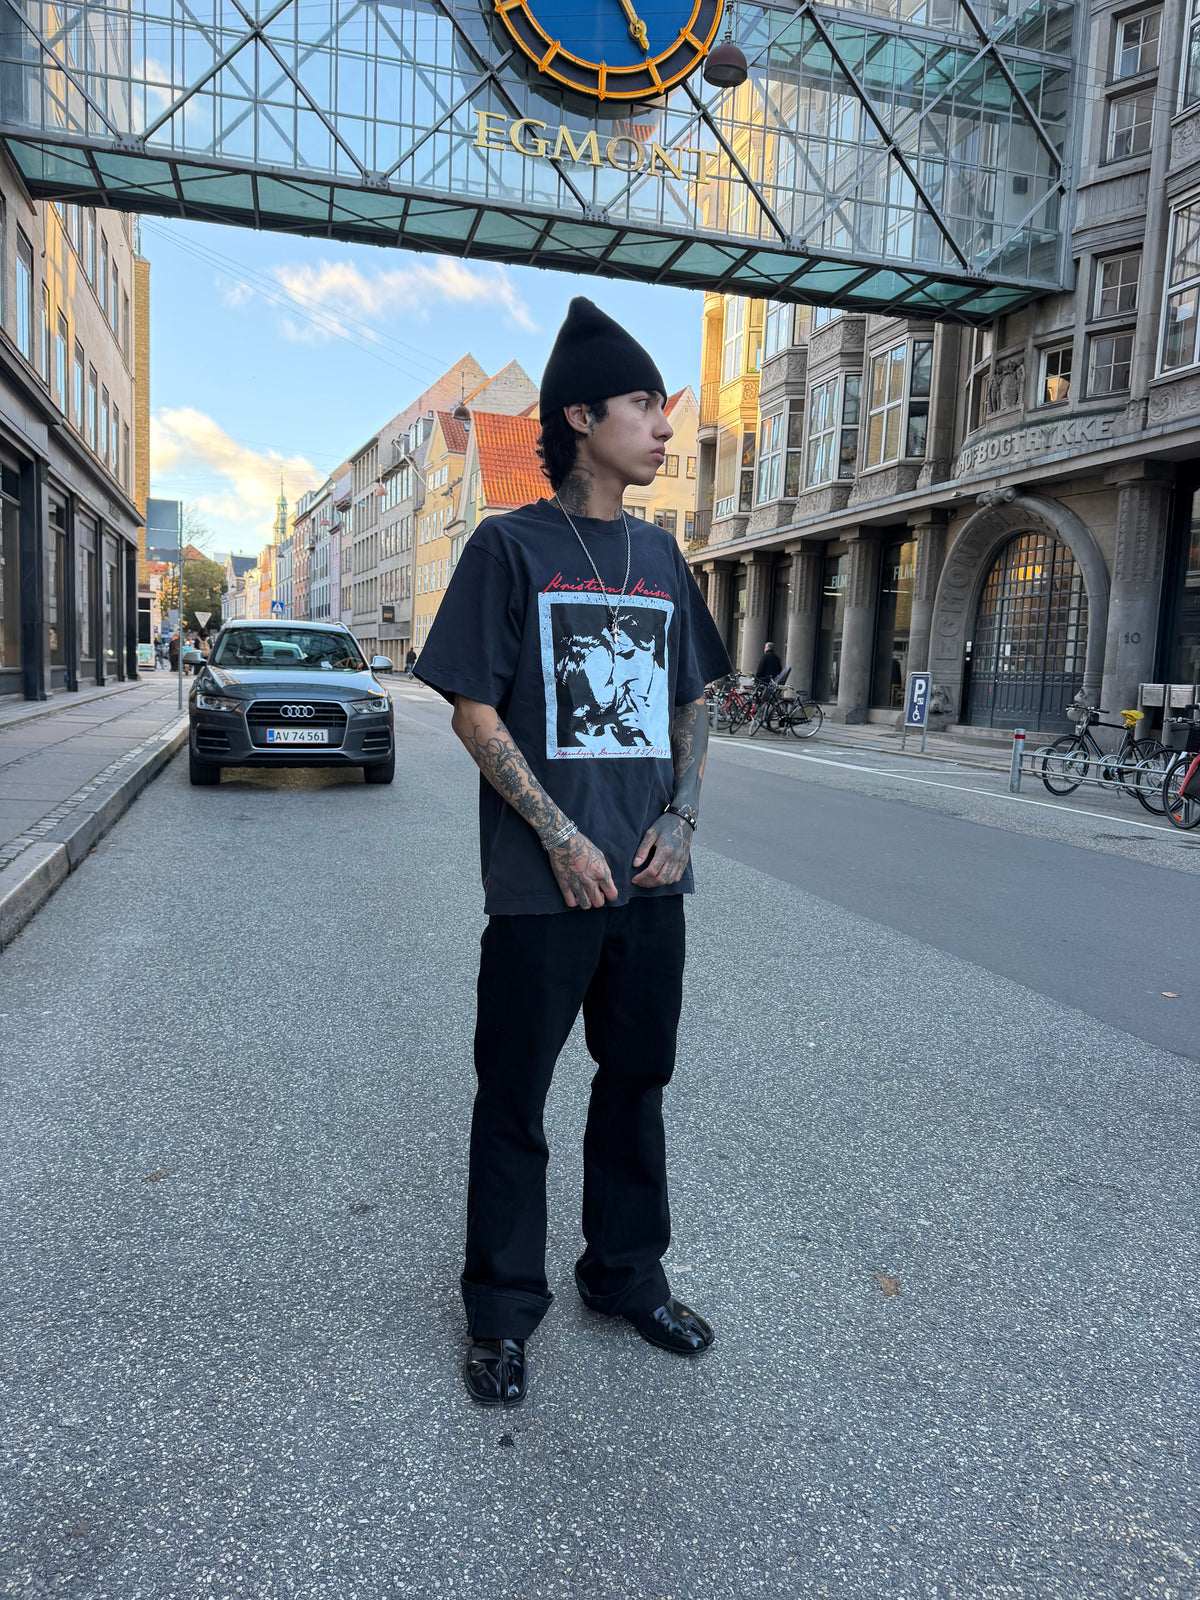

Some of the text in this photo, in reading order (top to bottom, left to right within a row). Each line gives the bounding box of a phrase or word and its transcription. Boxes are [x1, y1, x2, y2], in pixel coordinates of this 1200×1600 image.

[473, 110, 719, 184] EGMONT
[1124, 632, 1141, 645] 10
[913, 679, 926, 703] P
[275, 731, 325, 741] AV 74 561
